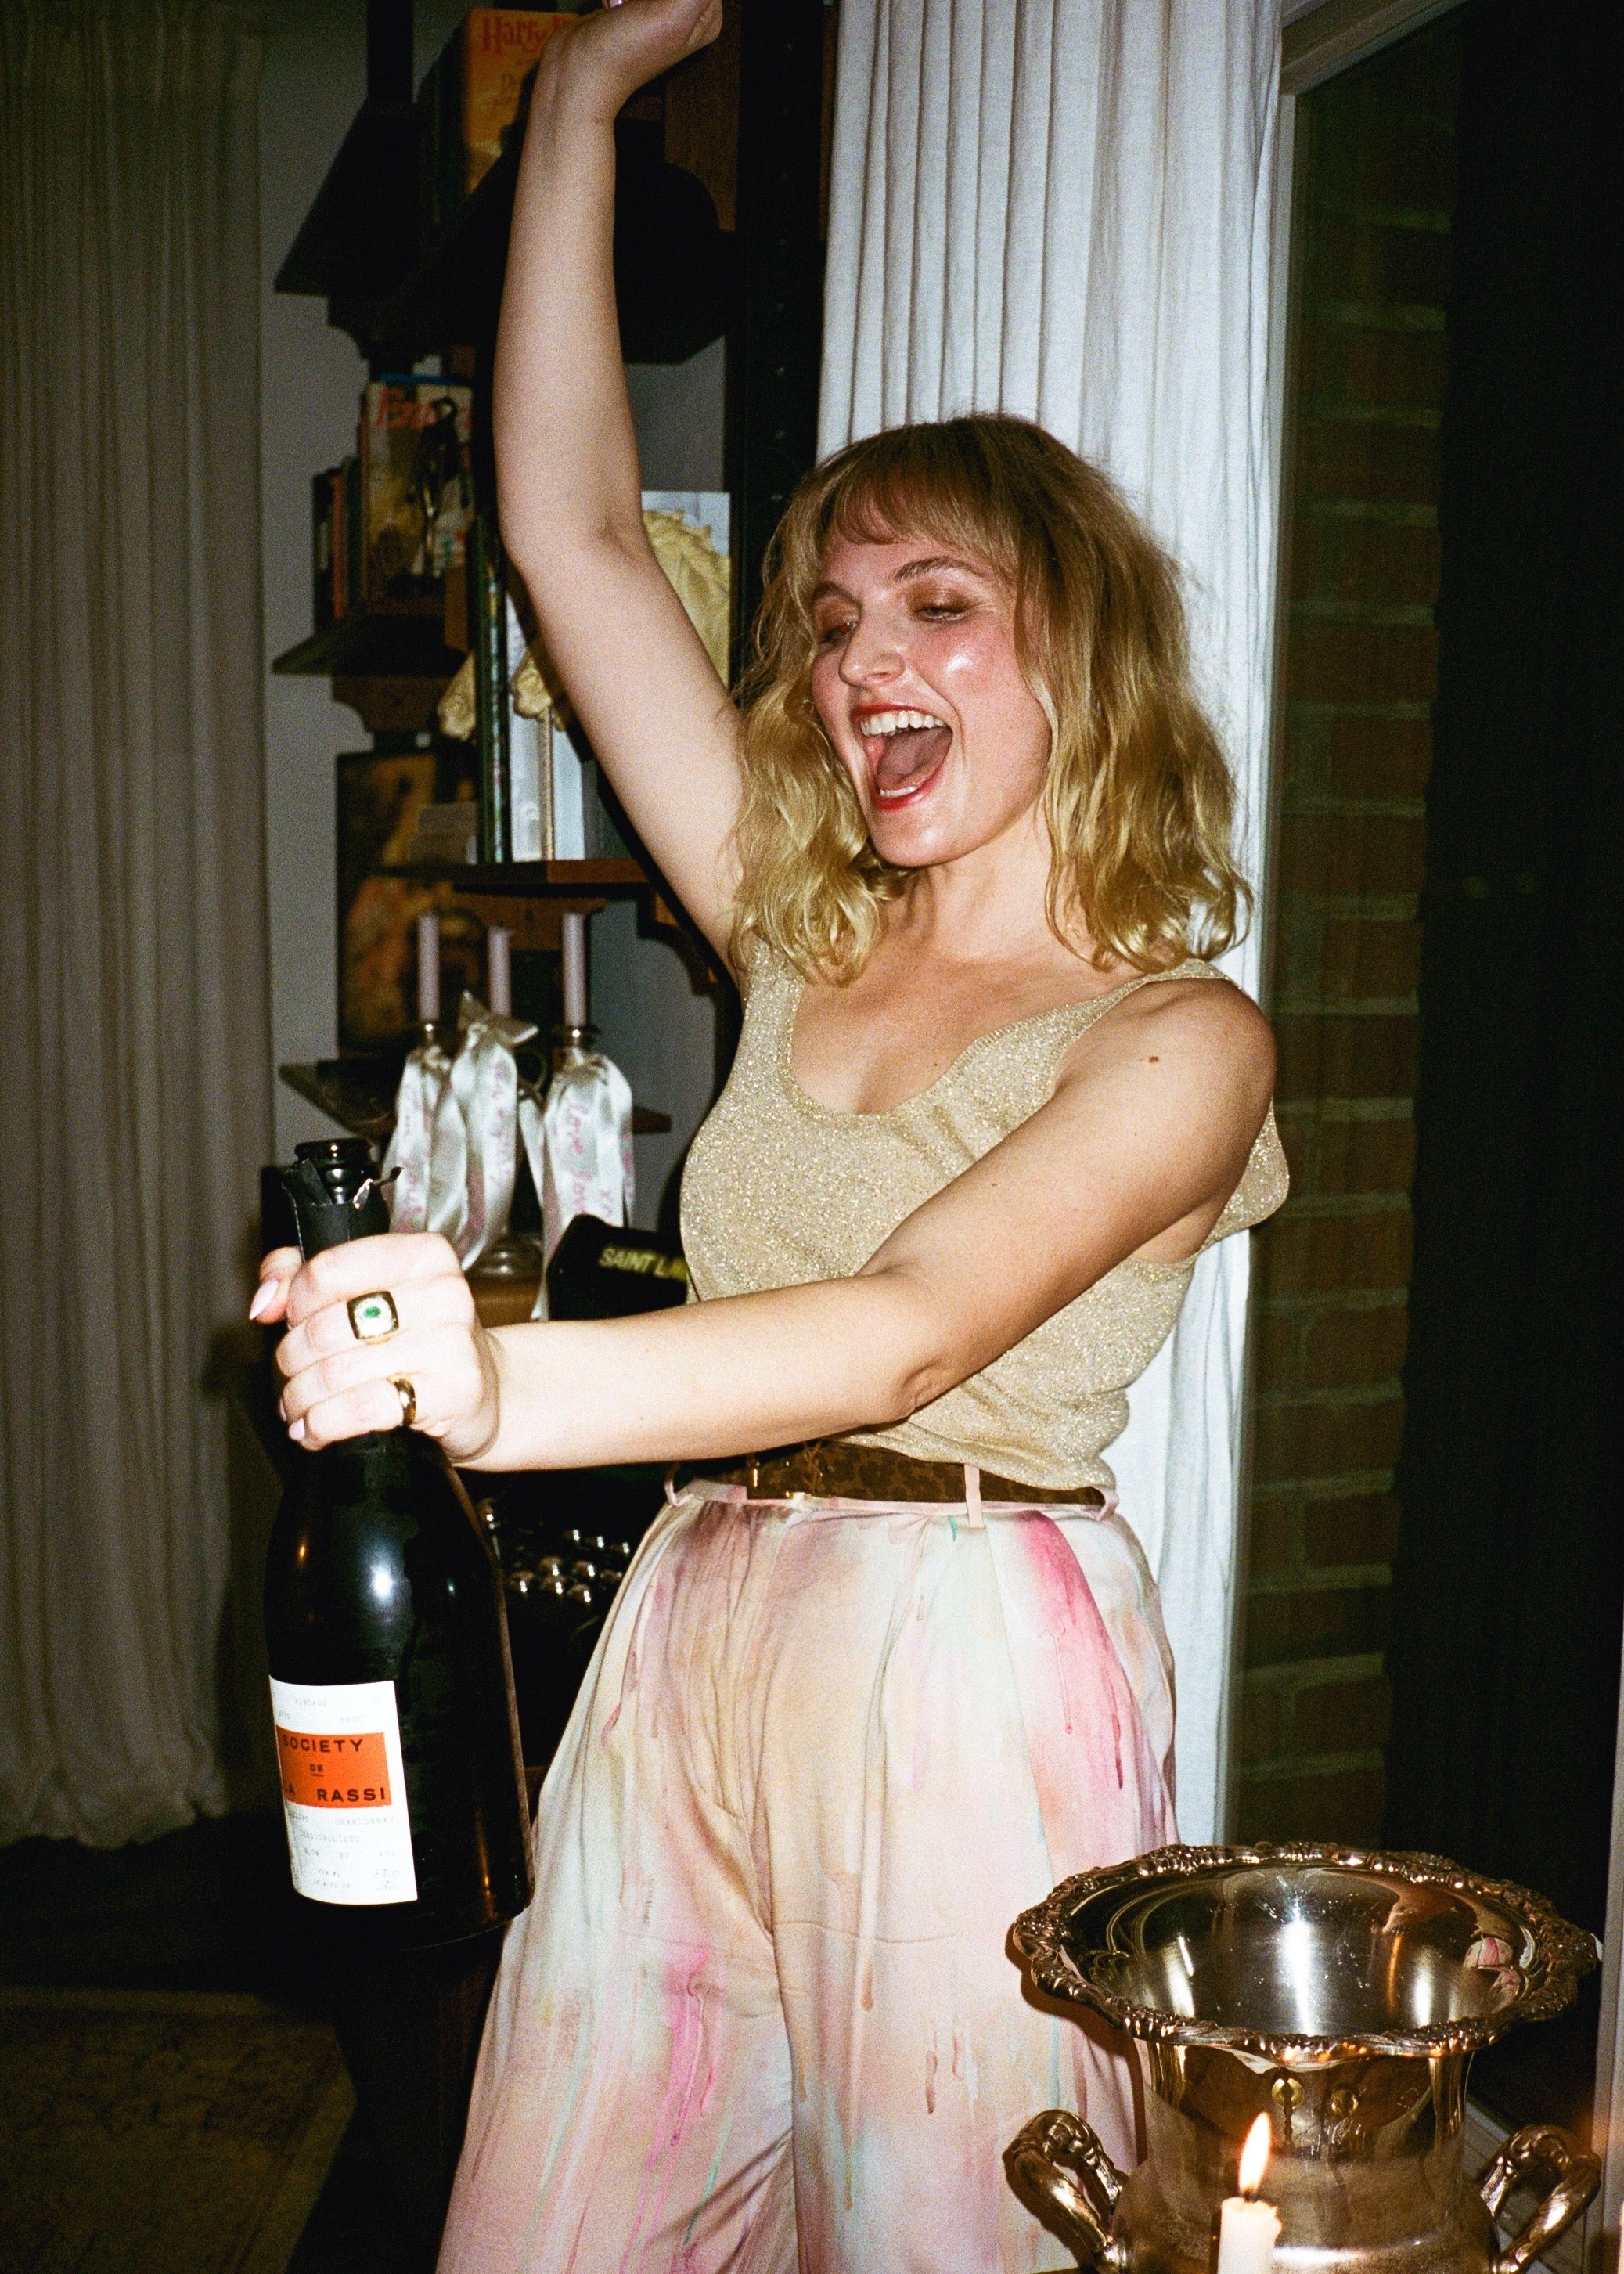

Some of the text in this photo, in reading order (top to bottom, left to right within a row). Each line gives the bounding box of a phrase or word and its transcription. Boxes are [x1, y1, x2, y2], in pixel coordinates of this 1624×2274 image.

[482, 16, 547, 56] Harry
[598, 1246, 656, 1273] SAINT
[282, 1734, 363, 1753] SOCIETY
[316, 1787, 385, 1802] RASSI
